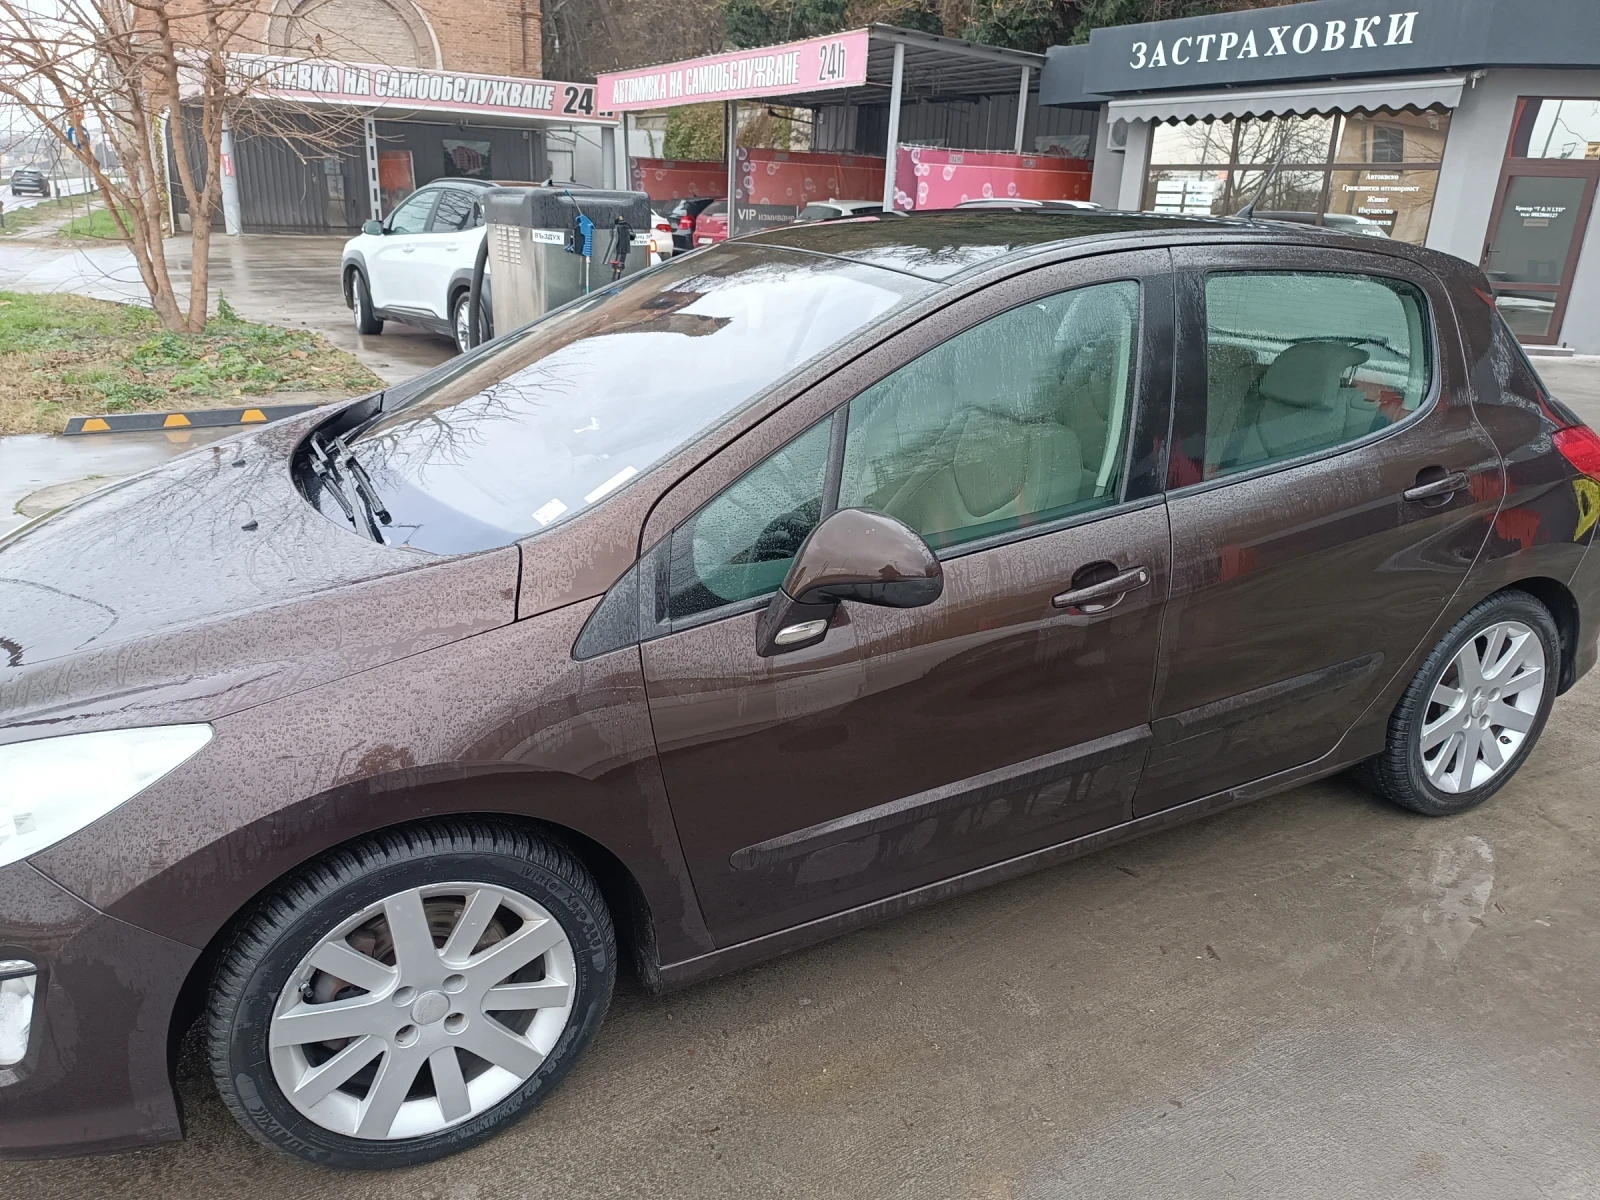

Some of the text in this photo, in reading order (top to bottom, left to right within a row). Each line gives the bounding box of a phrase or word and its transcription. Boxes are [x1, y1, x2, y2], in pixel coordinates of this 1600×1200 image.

[1129, 11, 1420, 69] ЗАСТРАХОВКИ
[343, 66, 371, 96] НА
[374, 69, 556, 110] САМООБСЛУЖВАНЕ
[612, 42, 846, 105] АВТОМИВКА НА САМООБСЛУЖВАНЕ 24h
[737, 208, 757, 220] VIP
[534, 233, 561, 241] ВЪЗДУХ
[519, 865, 563, 893] Winter
